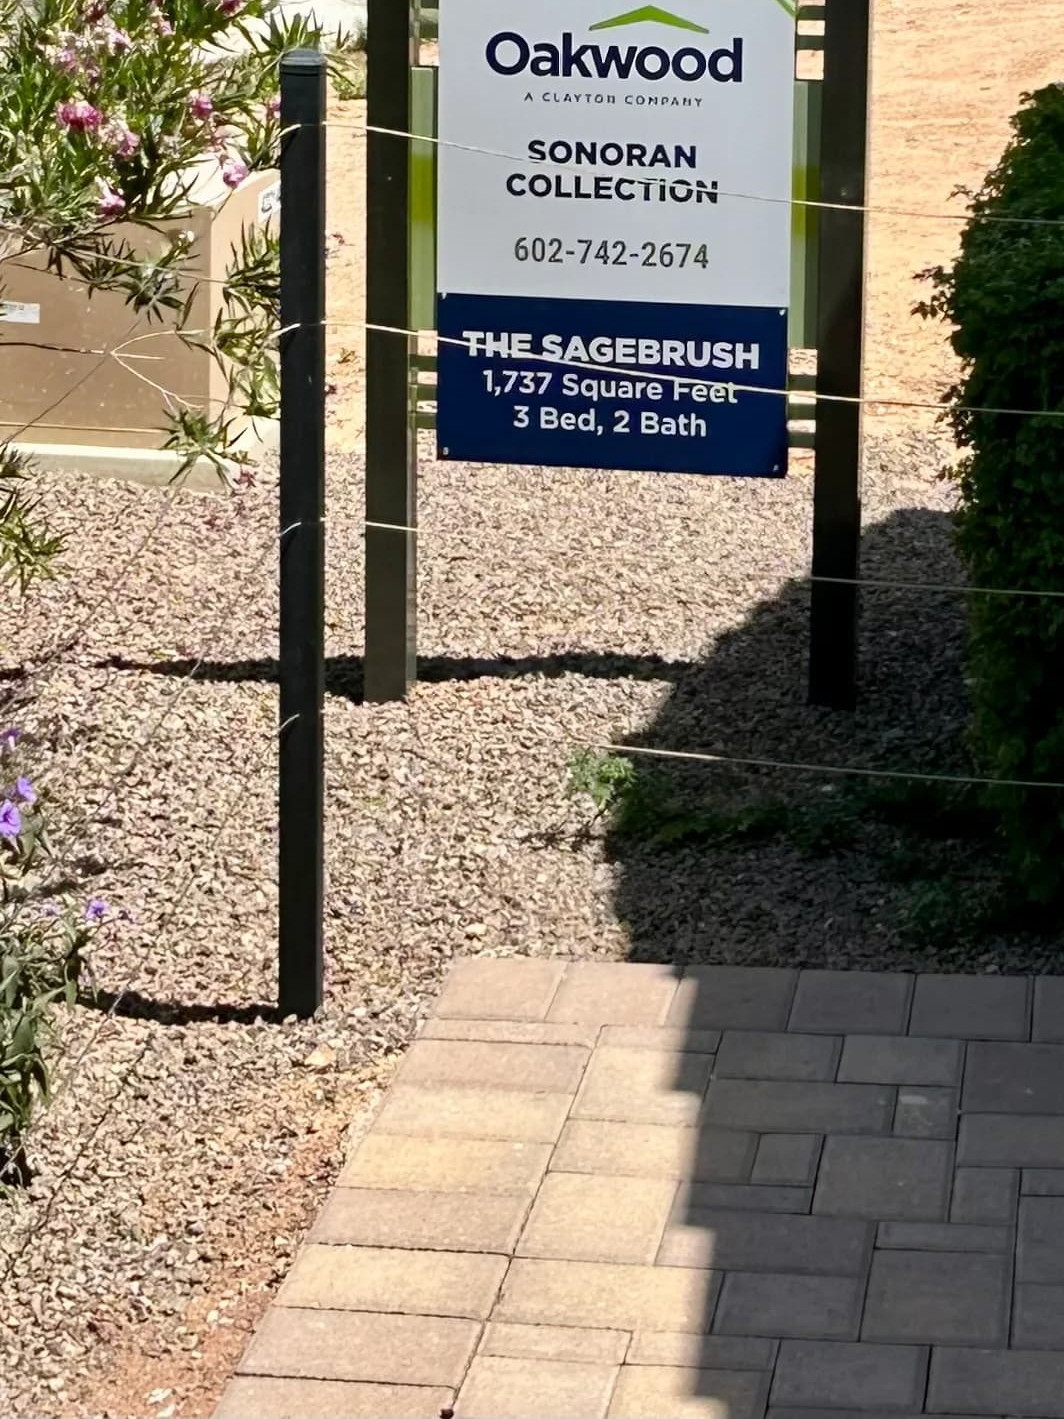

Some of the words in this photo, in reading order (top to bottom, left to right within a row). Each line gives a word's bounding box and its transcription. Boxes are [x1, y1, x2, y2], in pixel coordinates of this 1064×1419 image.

[485, 32, 743, 83] Oakwood
[524, 92, 534, 102] A
[542, 92, 616, 104] CLAYTON
[624, 95, 704, 107] COMPANY
[528, 140, 697, 169] SONORAN
[506, 173, 719, 204] COLLECTION
[514, 237, 709, 269] 602-742-2674
[462, 331, 533, 359] THE
[541, 334, 760, 370] SAGEBRUSH
[483, 369, 552, 397] 1,737
[562, 374, 663, 401] Square
[673, 380, 738, 404] Feet
[513, 406, 529, 428] 3
[540, 407, 603, 436] Bed,
[613, 410, 630, 433] 2
[641, 412, 707, 437] Bath
